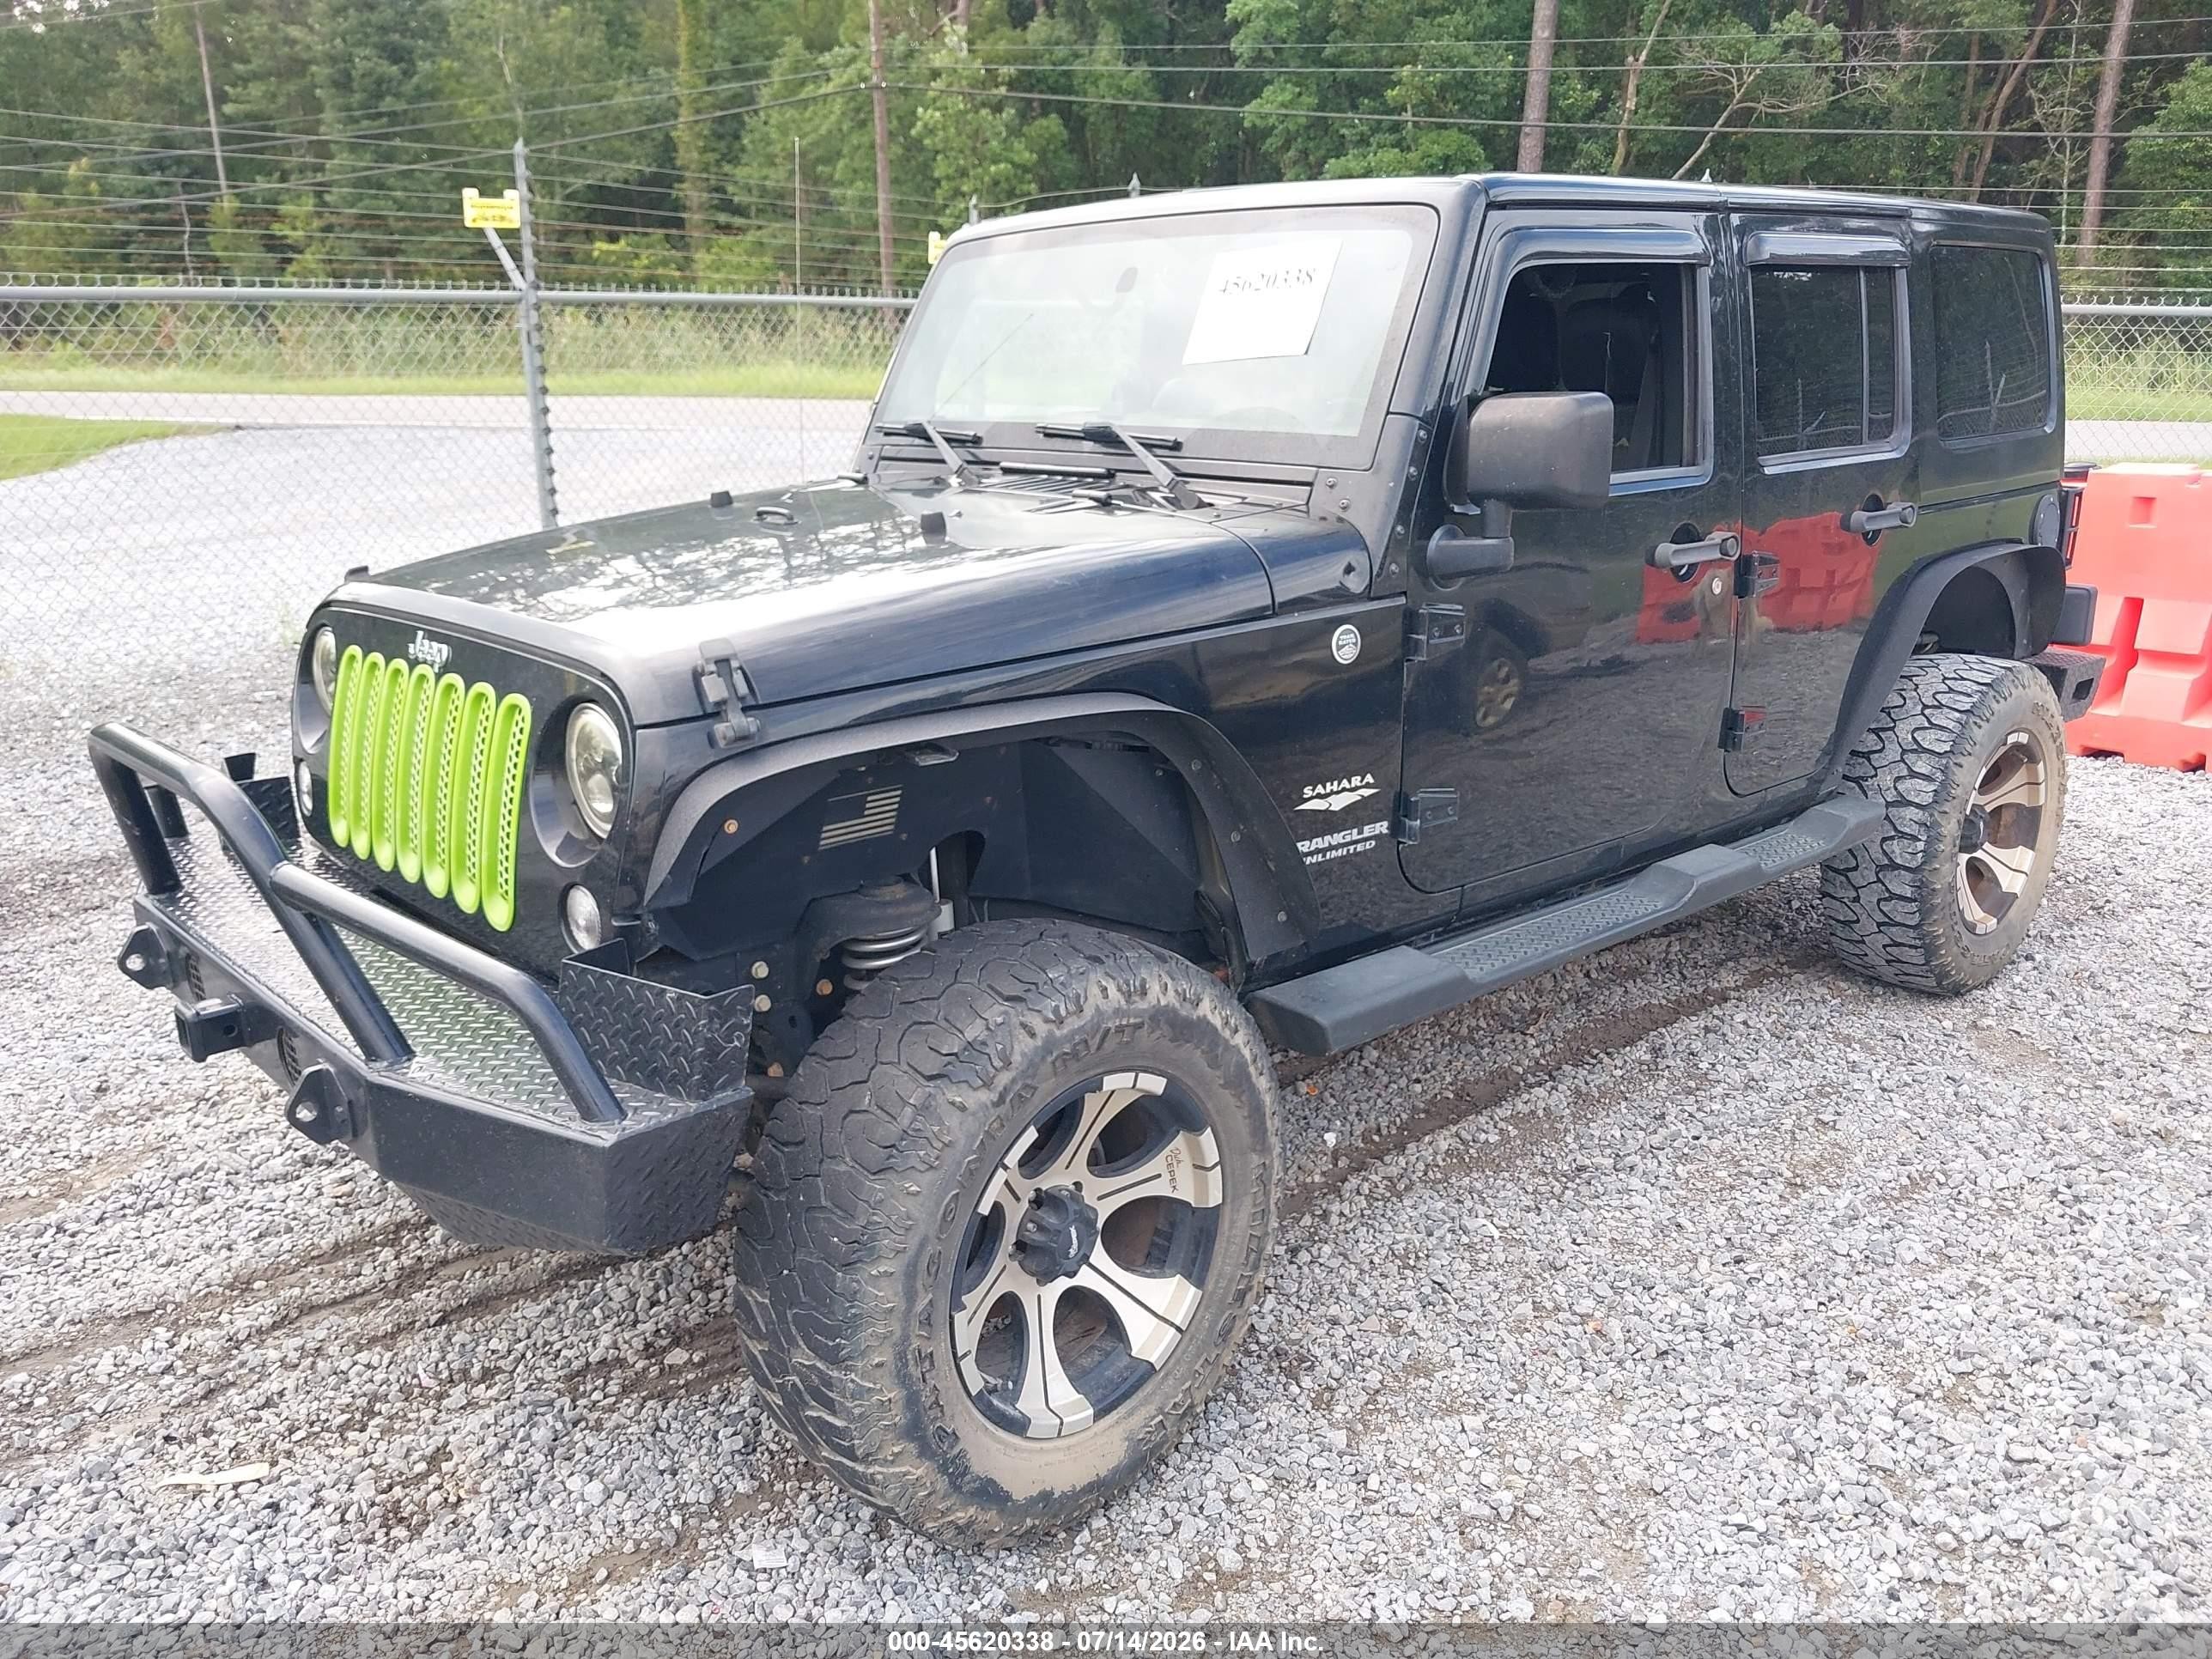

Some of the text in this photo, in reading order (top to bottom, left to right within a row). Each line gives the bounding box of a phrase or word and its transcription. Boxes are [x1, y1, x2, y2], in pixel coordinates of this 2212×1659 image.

[1303, 772, 1375, 799] SAHARA
[1296, 820, 1389, 853] RANGLER
[1302, 840, 1376, 866] NLIMITED
[1164, 1153, 1179, 1194] CEPEK
